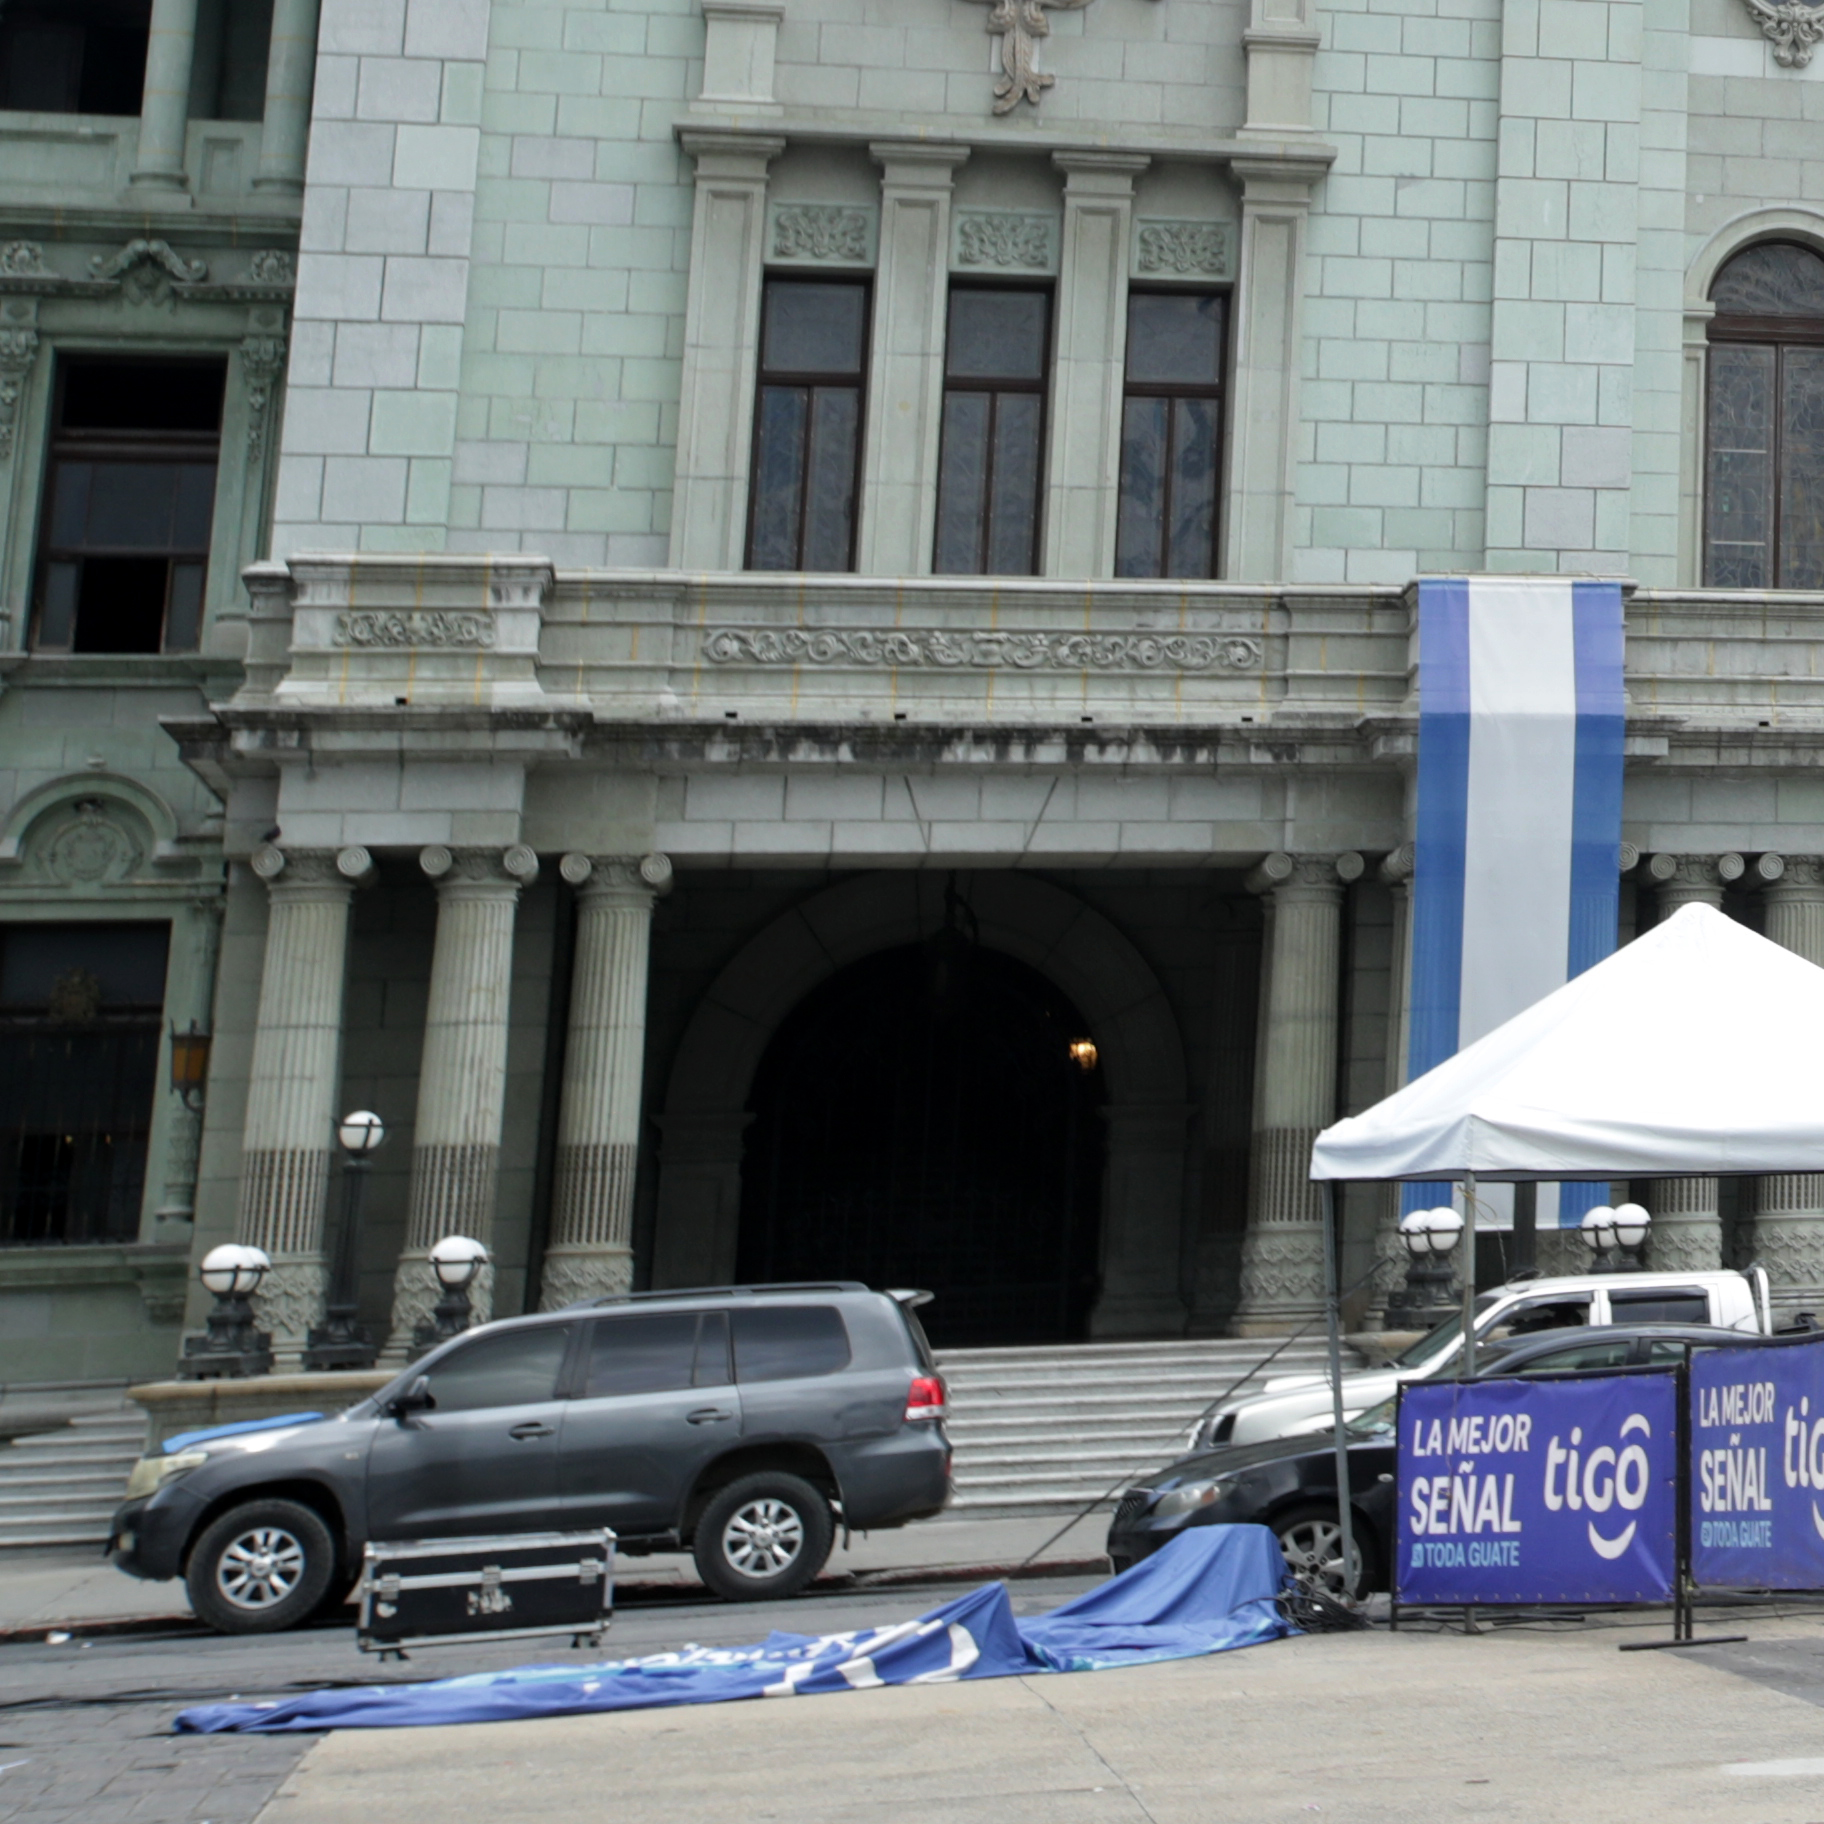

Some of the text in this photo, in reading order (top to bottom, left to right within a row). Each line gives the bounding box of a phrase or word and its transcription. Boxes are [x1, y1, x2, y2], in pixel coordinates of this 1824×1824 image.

[1700, 1382, 1775, 1427] LA MEJOR
[1413, 1414, 1532, 1456] LA MEJOR
[1701, 1433, 1772, 1512] SEÑAL
[1411, 1460, 1521, 1535] SEÑAL
[1424, 1542, 1466, 1567] TODA
[1469, 1541, 1520, 1566] GUATE
